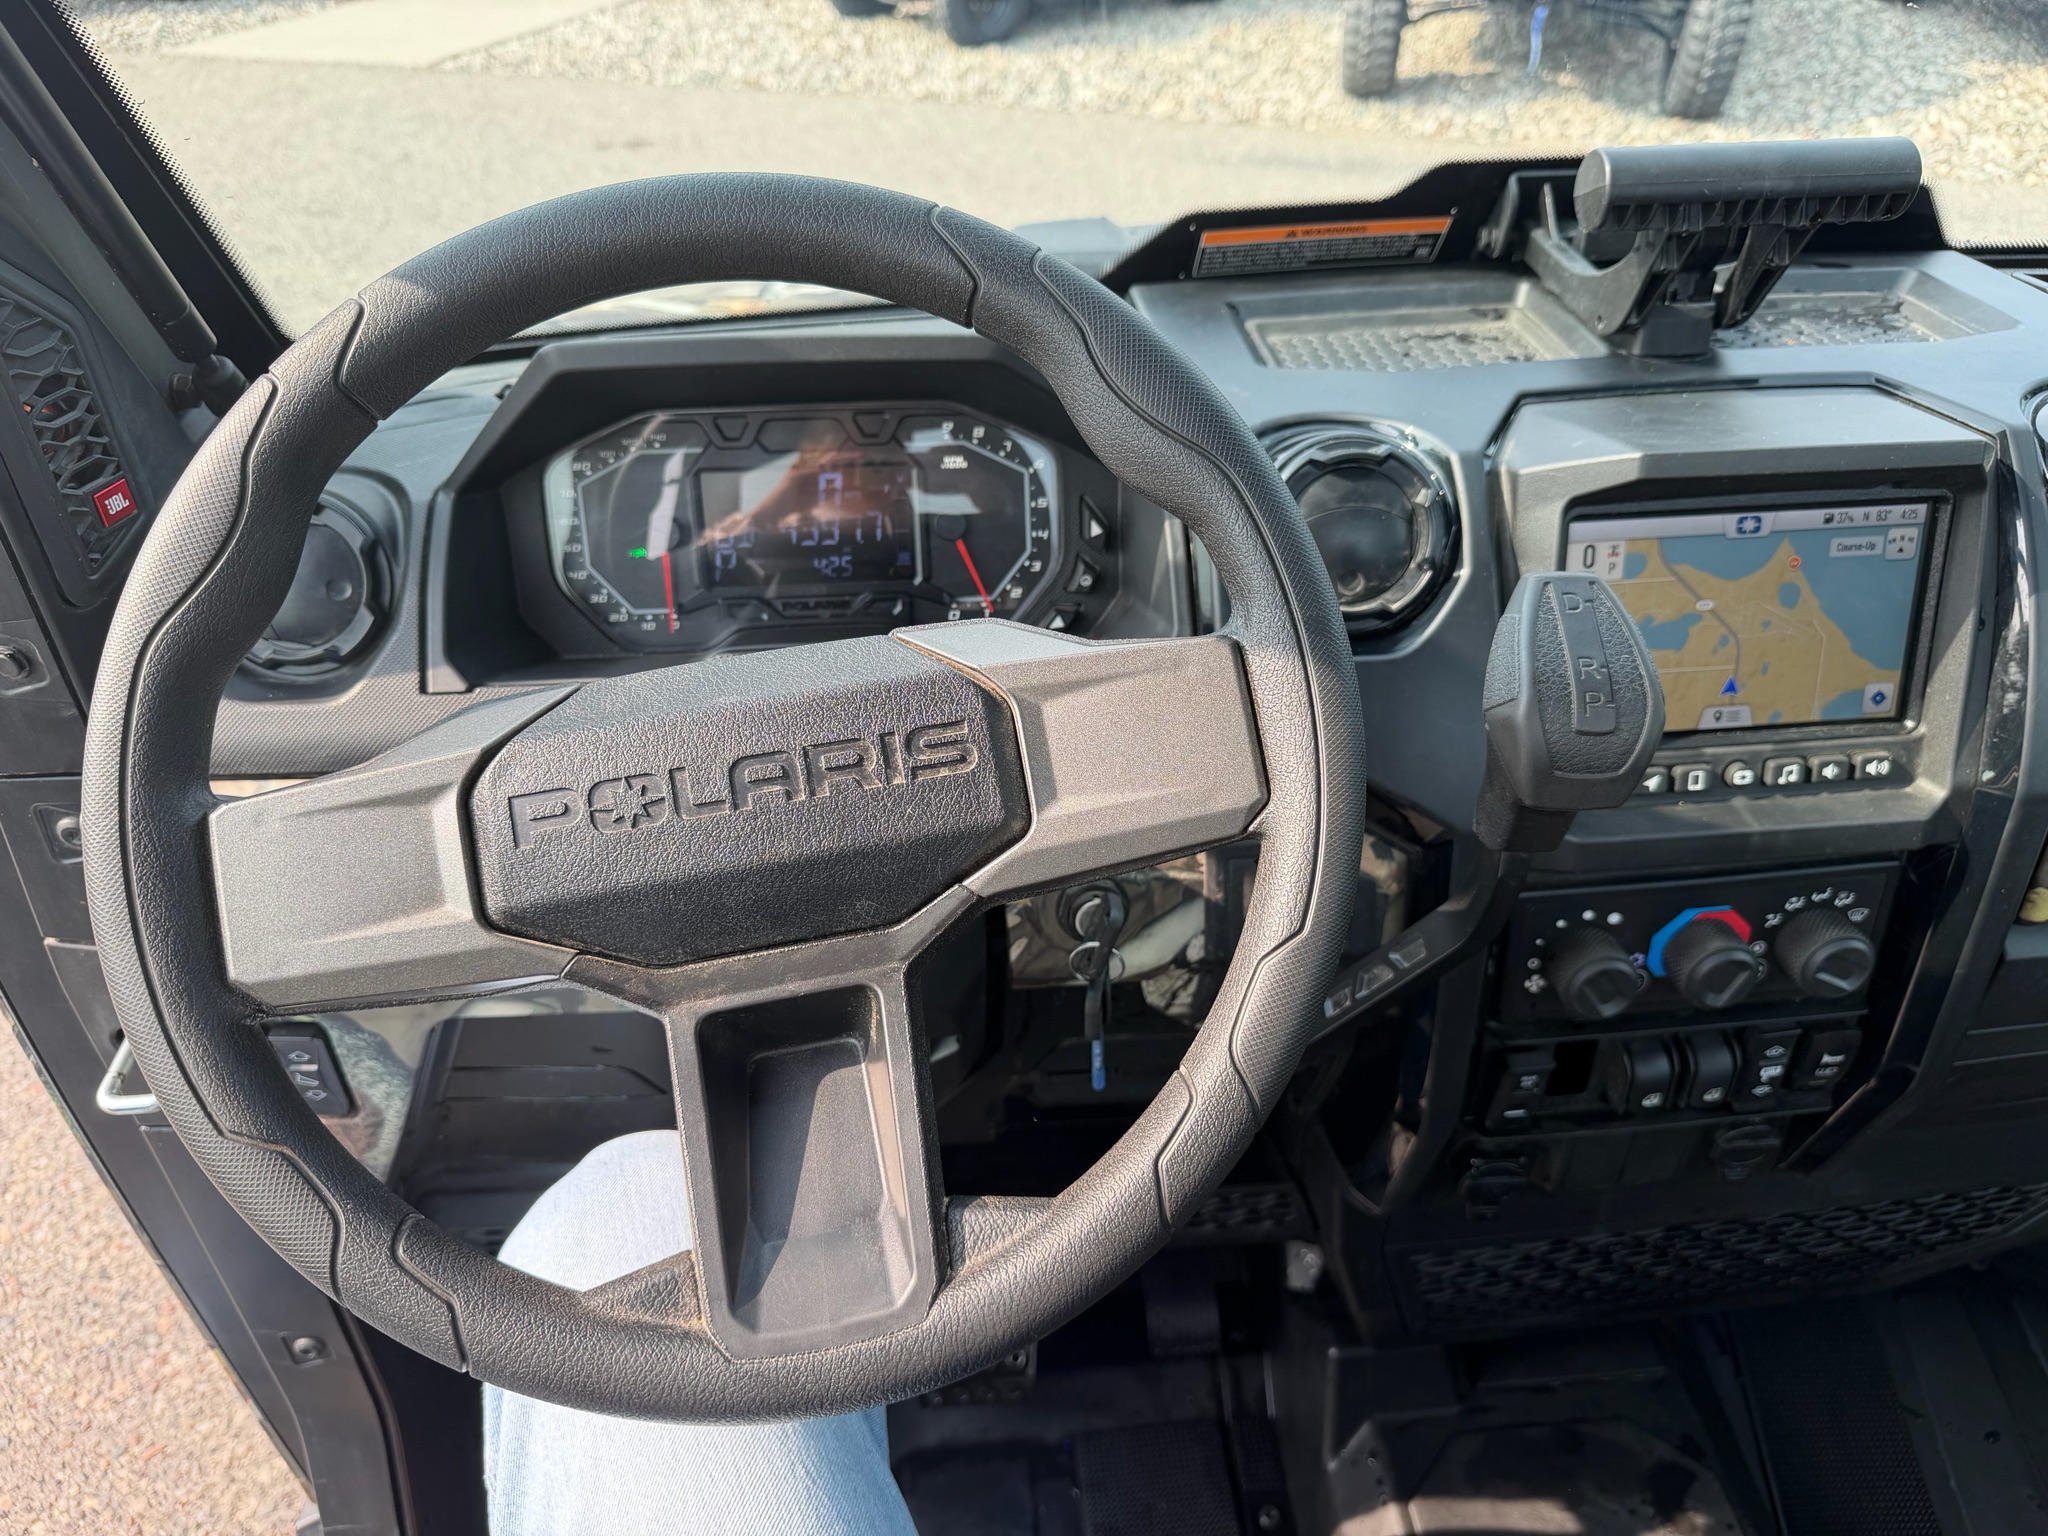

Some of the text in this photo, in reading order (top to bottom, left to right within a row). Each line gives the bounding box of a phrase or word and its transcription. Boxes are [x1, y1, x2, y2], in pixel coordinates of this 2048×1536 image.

[942, 421, 954, 432] 9
[972, 426, 985, 438] 8
[1003, 440, 1012, 452] 7
[105, 492, 130, 515] JBL
[1037, 498, 1048, 508] 5
[1837, 511, 1854, 524] 37%
[1863, 512, 1870, 521] N
[1038, 529, 1049, 540] 4
[1836, 541, 1876, 552] Course-Up
[1583, 544, 1596, 569] 0
[1029, 559, 1042, 572] 3
[1608, 562, 1616, 575] P
[569, 570, 587, 580] 40
[590, 593, 608, 603] 30
[1010, 587, 1023, 598] 2
[1561, 592, 1583, 613] D
[609, 613, 628, 622] 20
[948, 610, 961, 620] 0
[641, 621, 656, 631] 10
[1577, 656, 1601, 679] R
[1584, 691, 1604, 717] P
[508, 720, 978, 849] POLARIS
